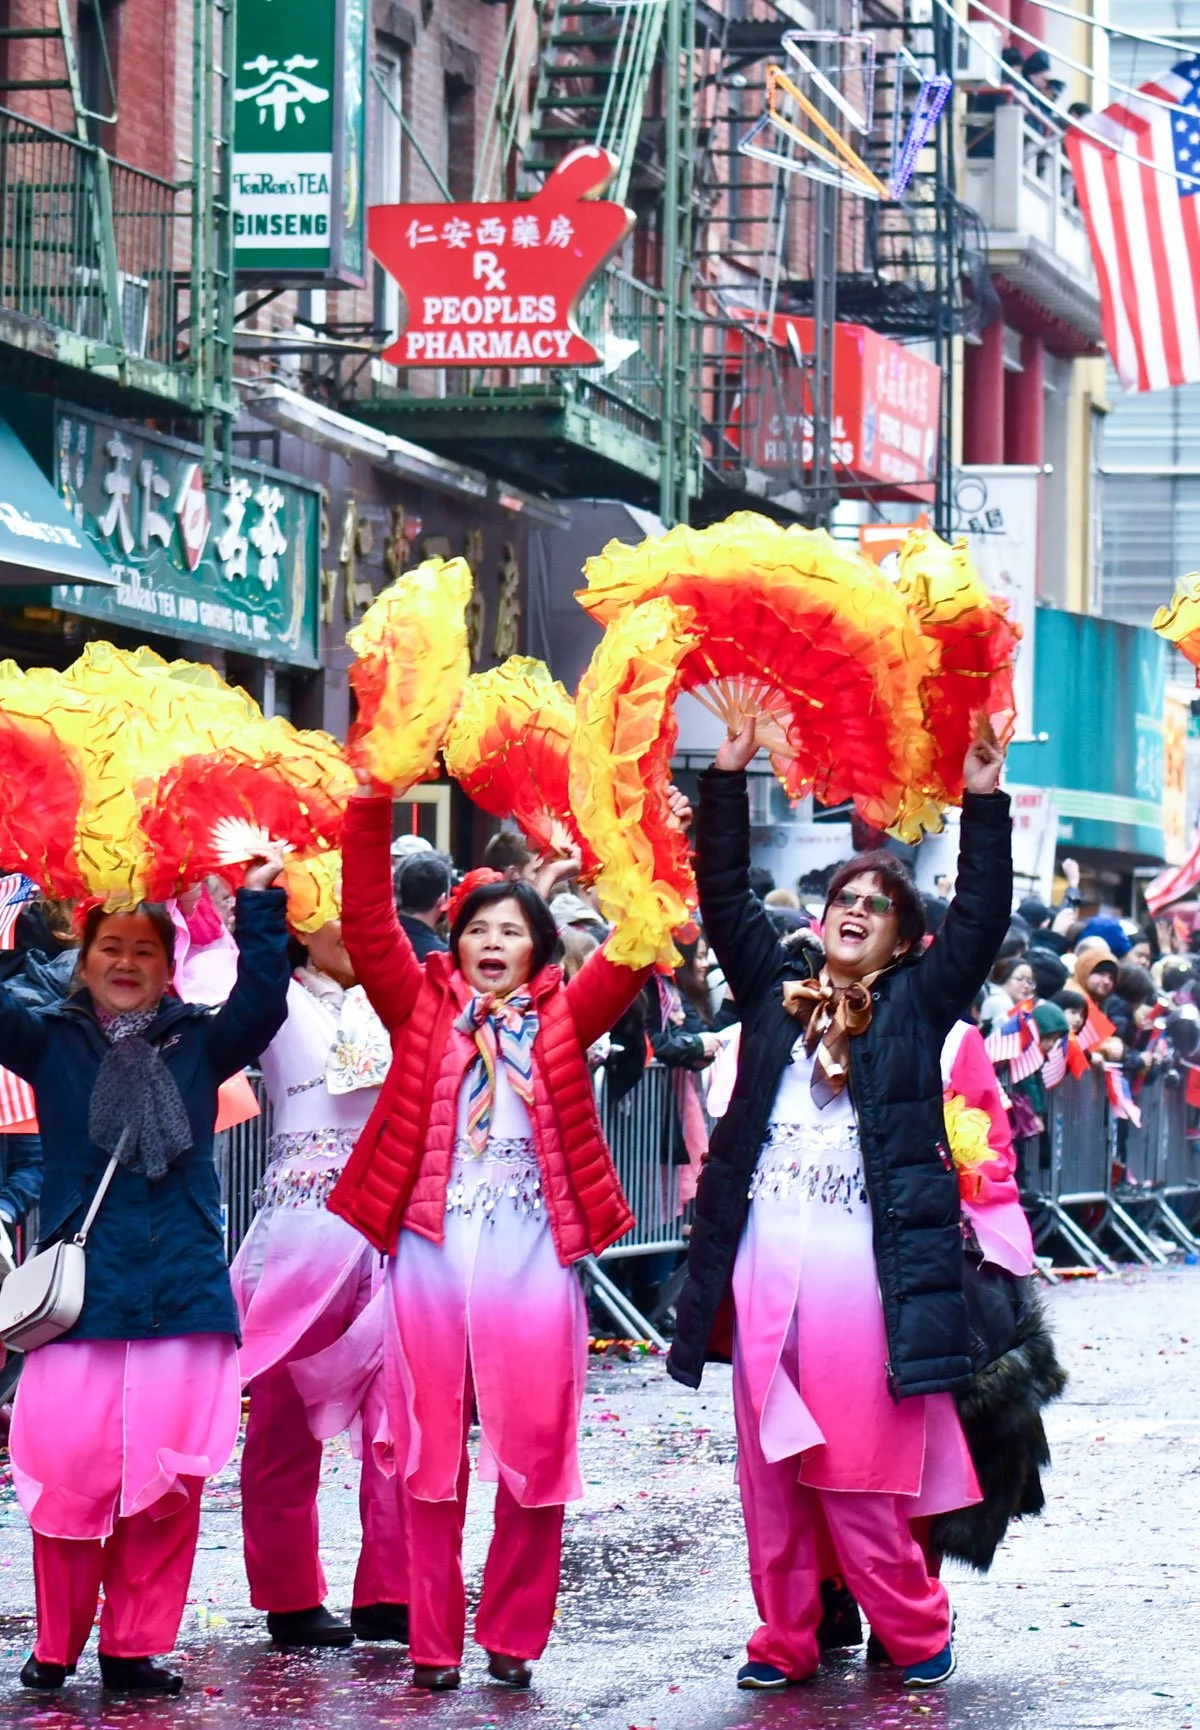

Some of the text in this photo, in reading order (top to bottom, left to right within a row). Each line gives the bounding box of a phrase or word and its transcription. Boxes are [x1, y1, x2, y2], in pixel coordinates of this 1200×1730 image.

[236, 55, 330, 132] 茶
[298, 172, 329, 195] TEA
[234, 213, 328, 236] GINSENG
[423, 296, 557, 325] PEOPLES
[406, 331, 573, 360] PHARMACY
